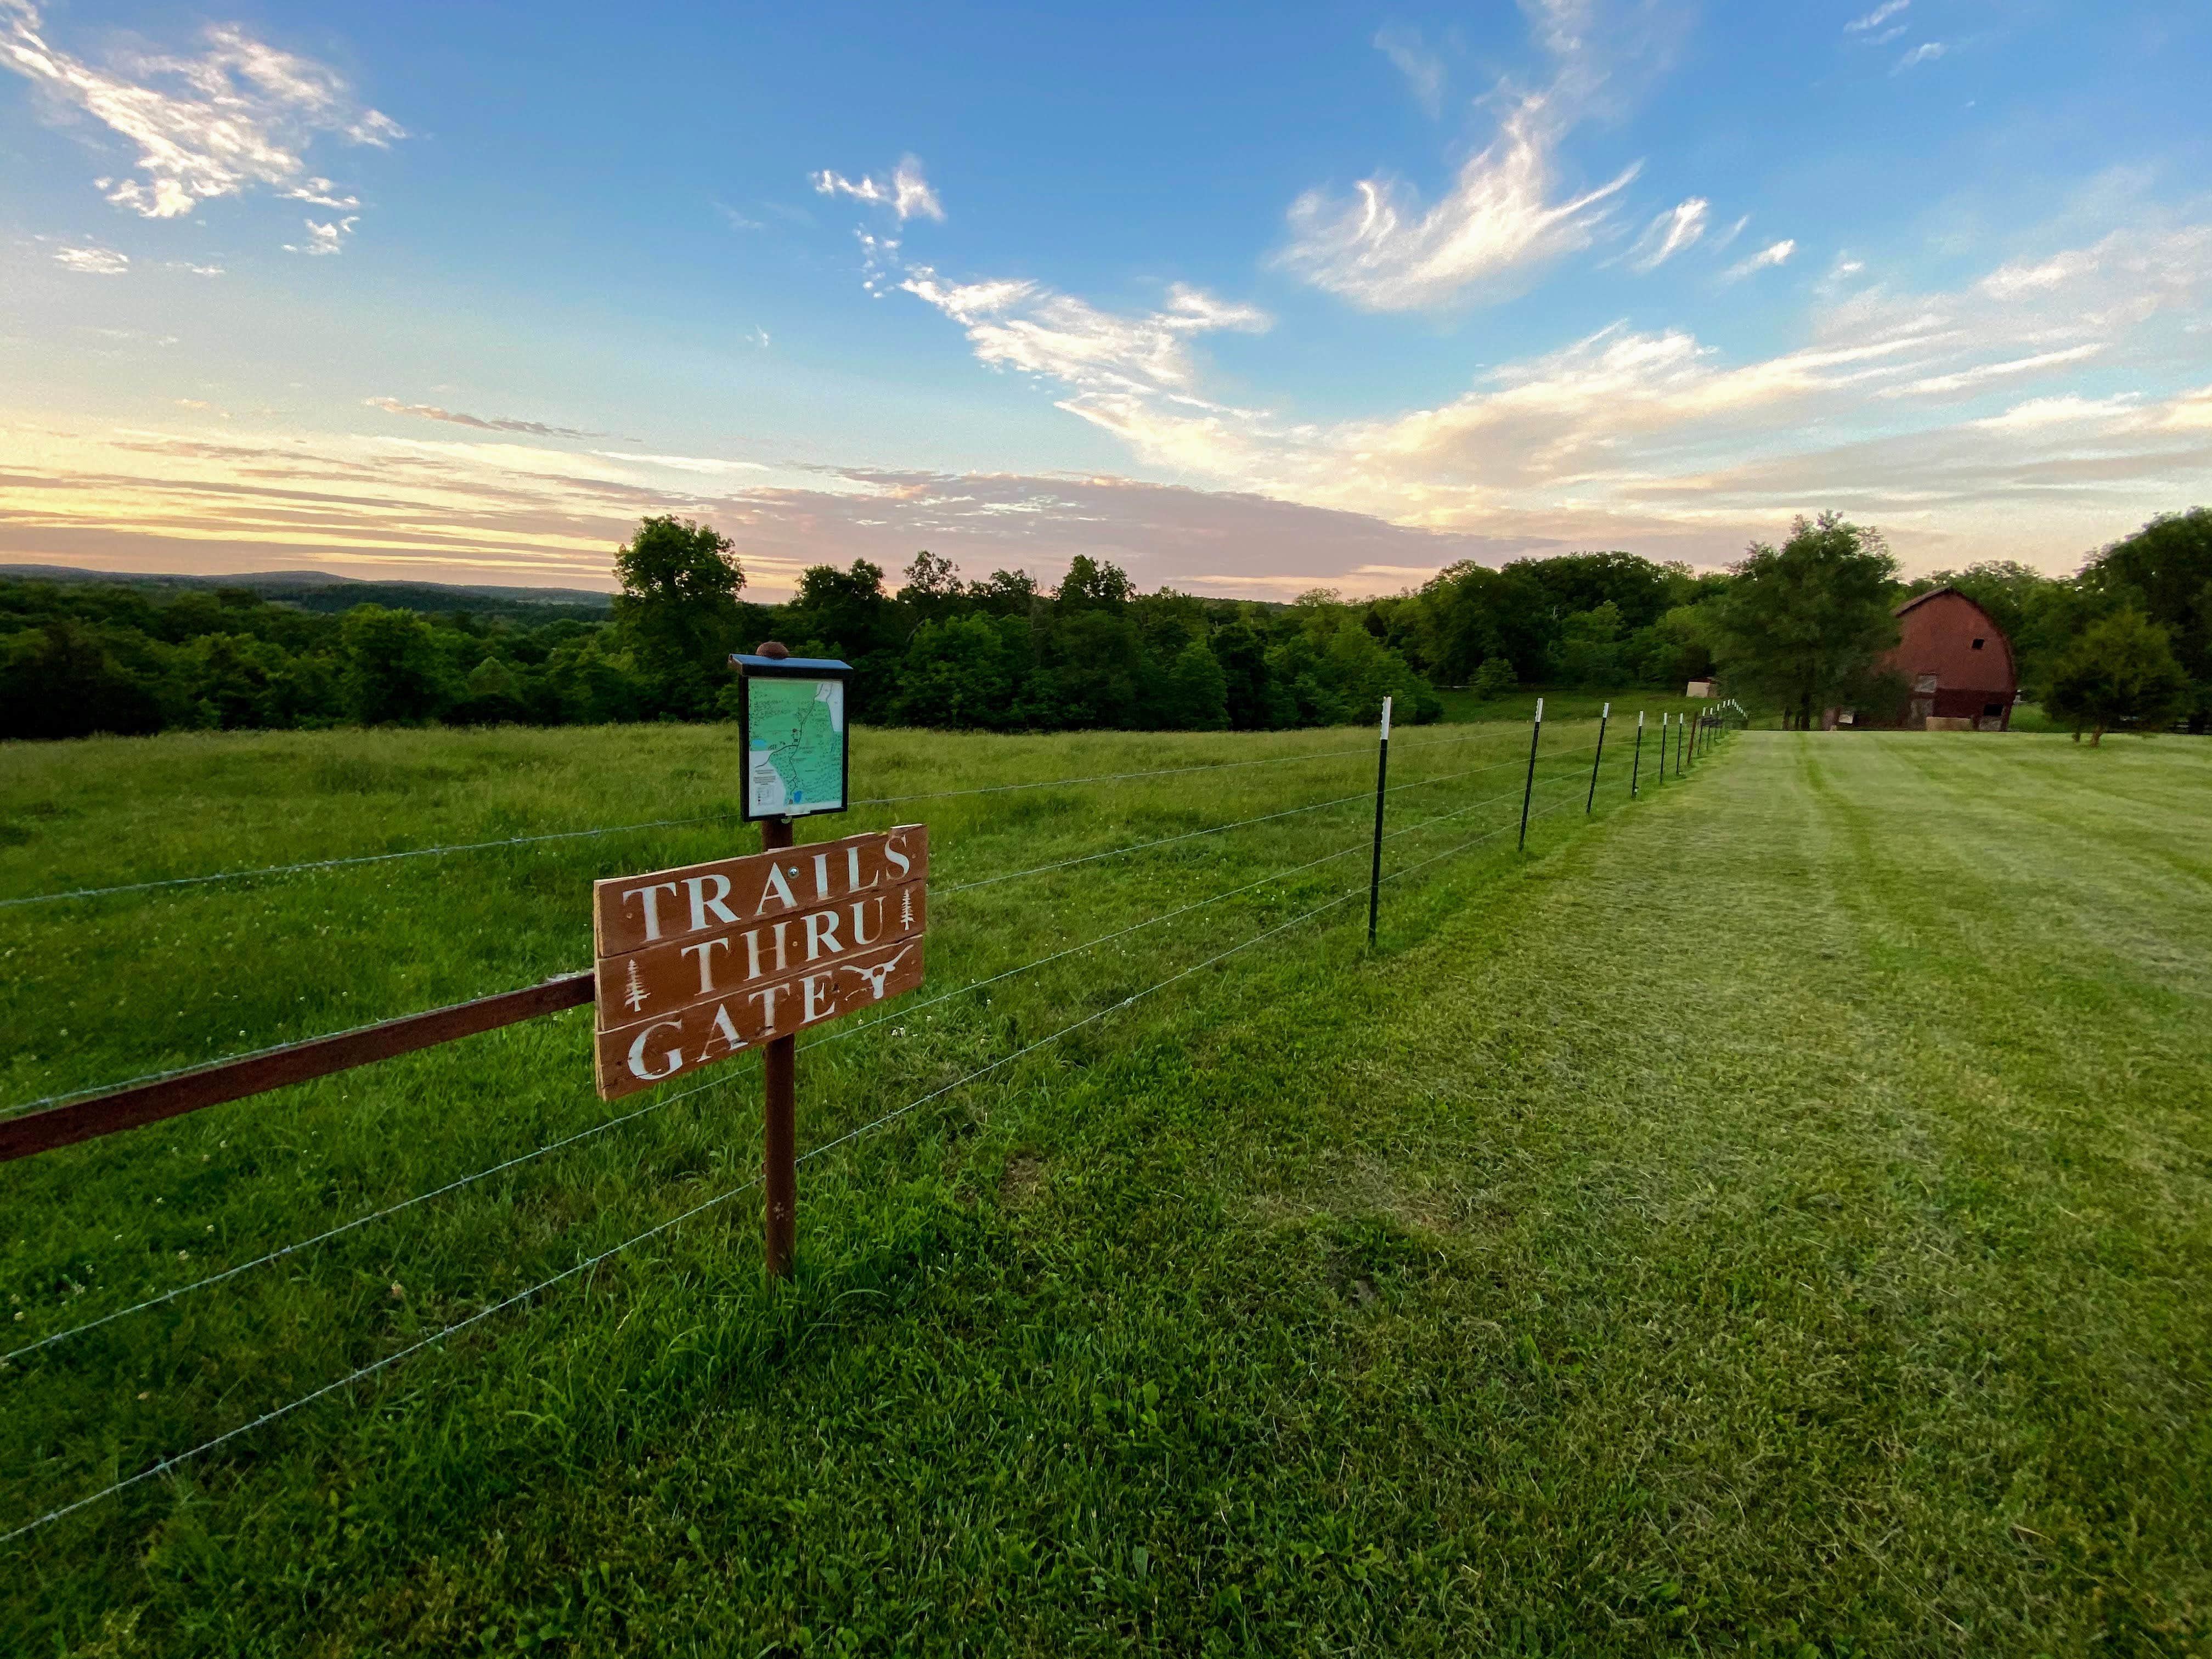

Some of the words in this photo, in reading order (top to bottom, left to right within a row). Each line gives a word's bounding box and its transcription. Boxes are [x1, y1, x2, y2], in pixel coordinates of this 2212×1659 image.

[623, 836, 911, 941] TRAILS
[681, 896, 886, 995] THRU
[628, 971, 836, 1080] GATE
